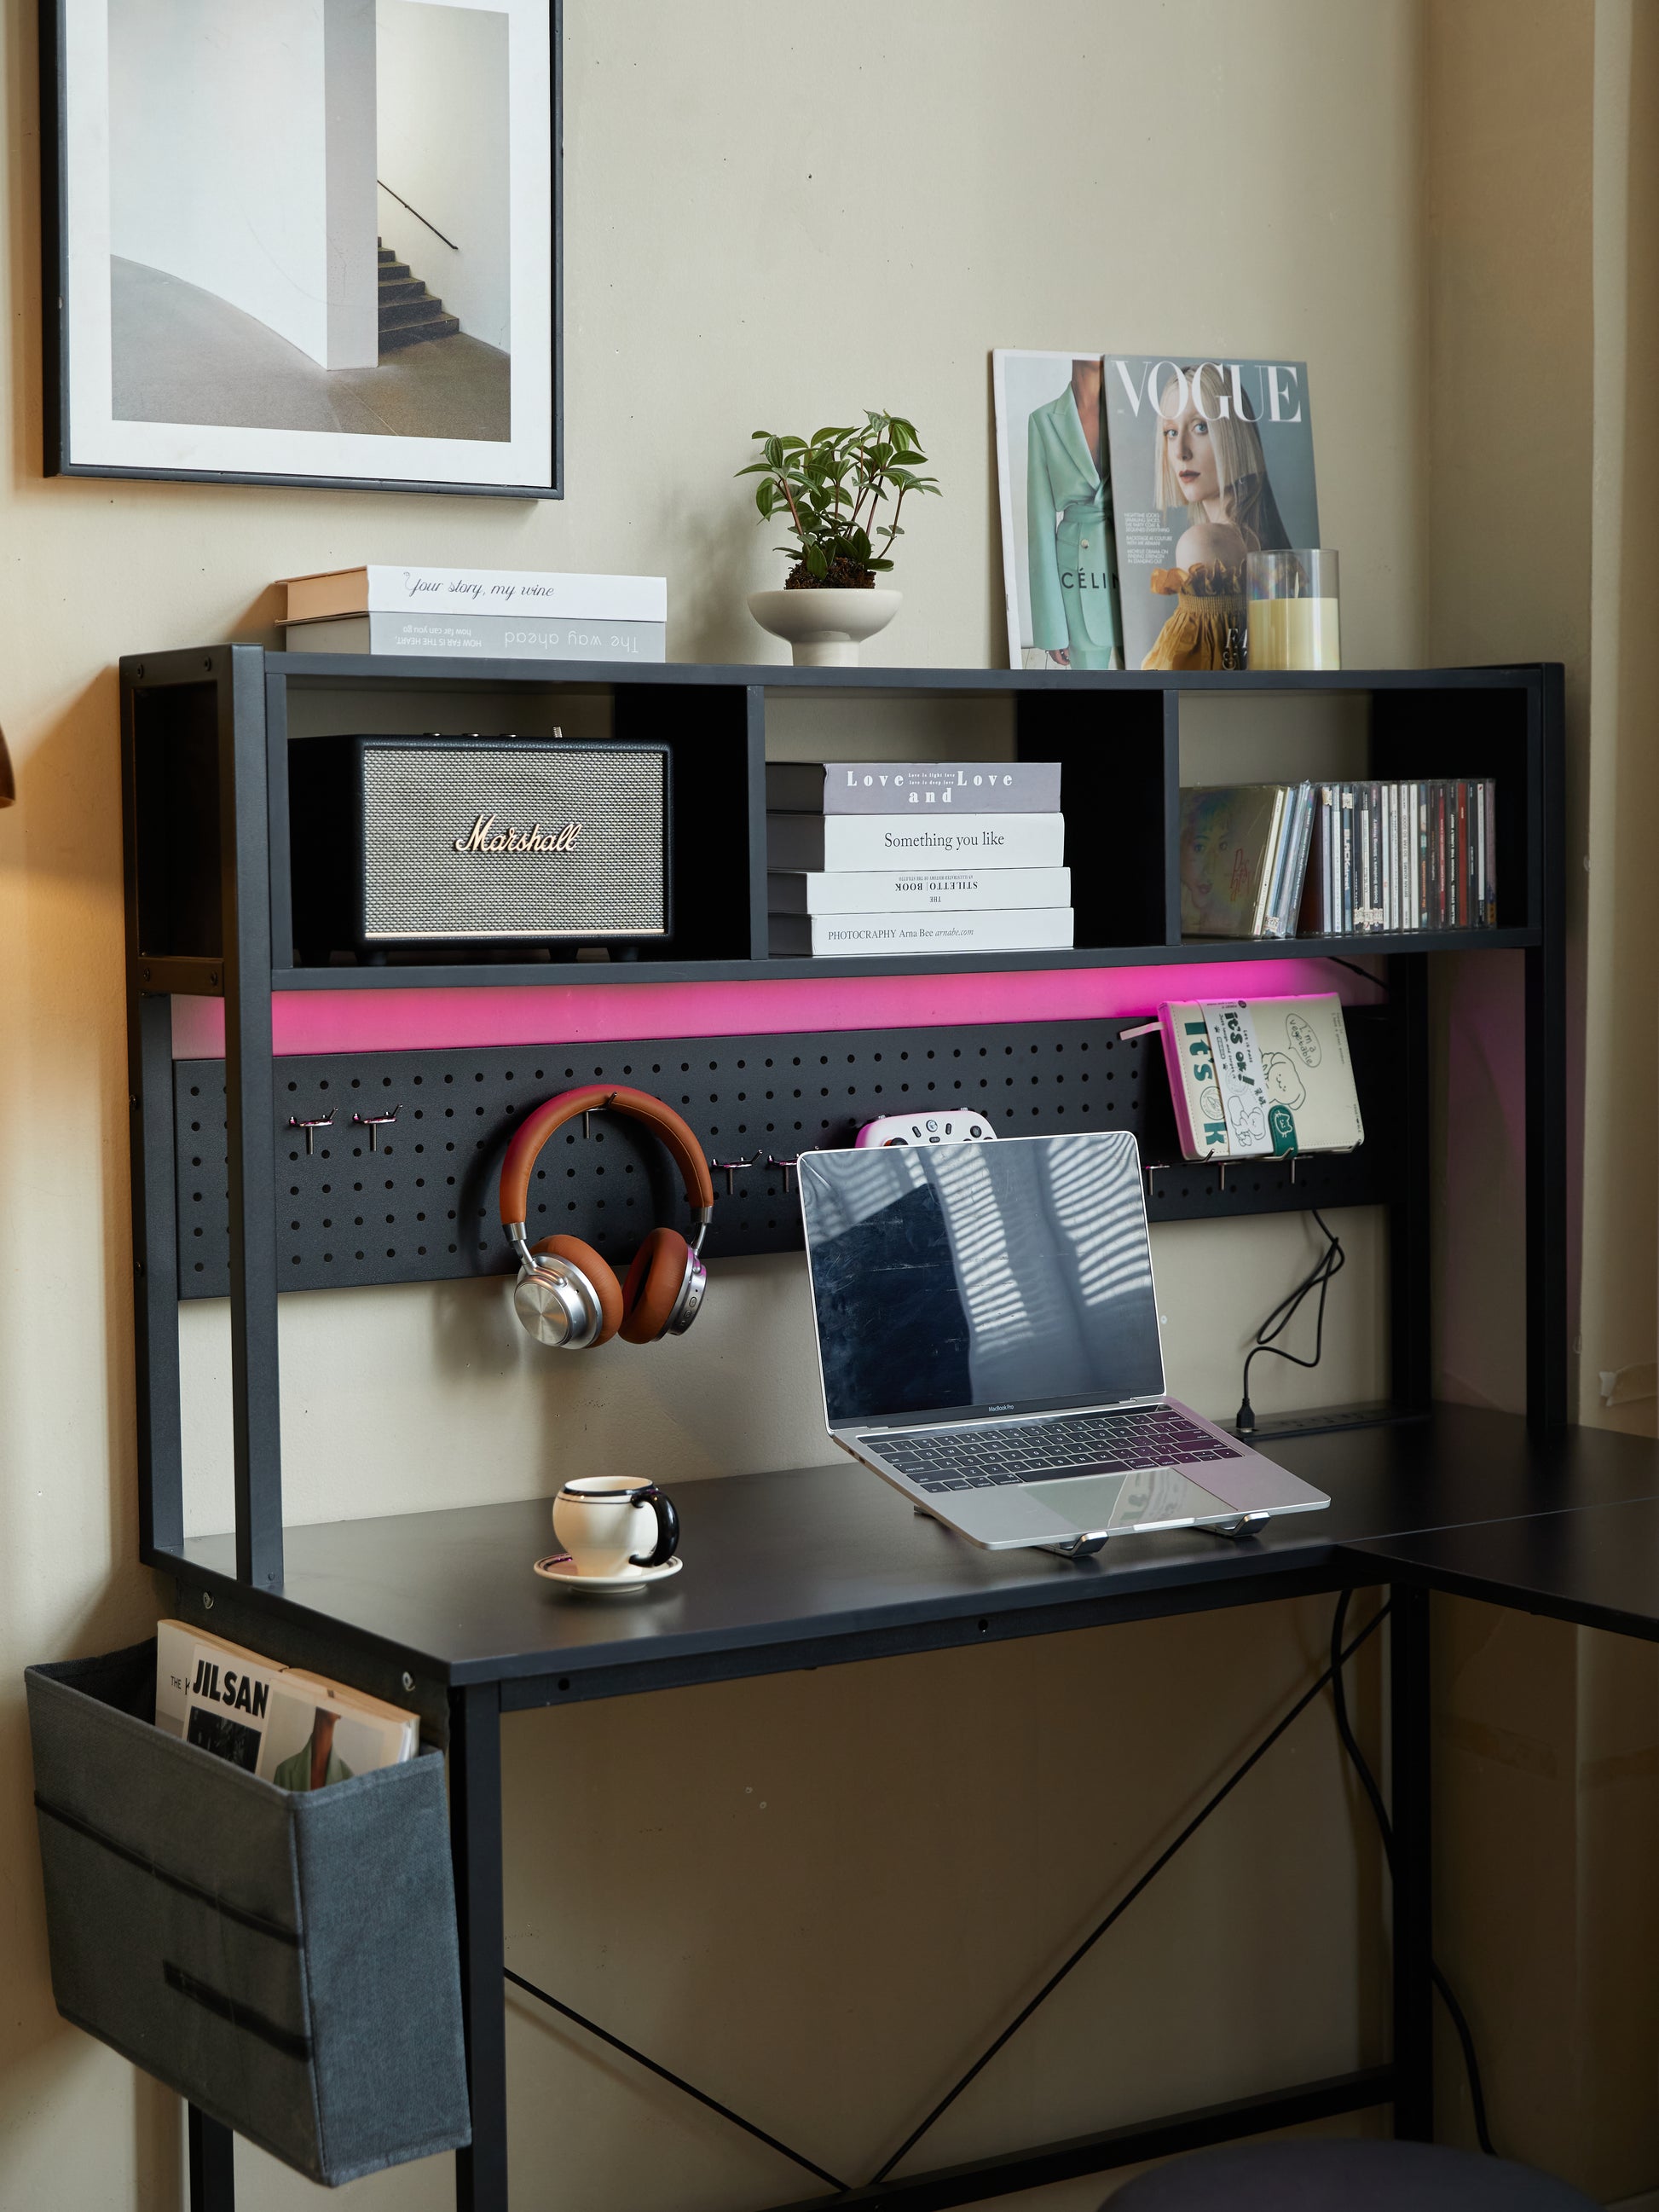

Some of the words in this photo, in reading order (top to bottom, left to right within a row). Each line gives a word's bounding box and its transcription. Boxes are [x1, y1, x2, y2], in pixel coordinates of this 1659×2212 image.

[1111, 360, 1302, 423] VOGUE
[448, 579, 486, 599] story,
[490, 584, 515, 601] my
[521, 584, 554, 597] wine
[396, 636, 421, 646] HEART,
[423, 637, 437, 646] THE
[448, 638, 461, 647] FAR
[463, 639, 482, 647] HOW
[505, 631, 559, 650] ahead
[568, 630, 602, 646] way
[610, 635, 639, 653] The
[847, 770, 904, 786] Love
[957, 770, 1013, 786] Love
[908, 787, 952, 803] and
[455, 814, 583, 853] Marshall
[884, 832, 953, 851] Something
[956, 836, 980, 850] you
[982, 831, 1005, 847] like
[895, 883, 923, 891] BOOK
[929, 881, 978, 890] STILETTO
[919, 928, 934, 937] Bee
[1290, 1019, 1313, 1064] vegetable
[171, 1675, 182, 1689] THE
